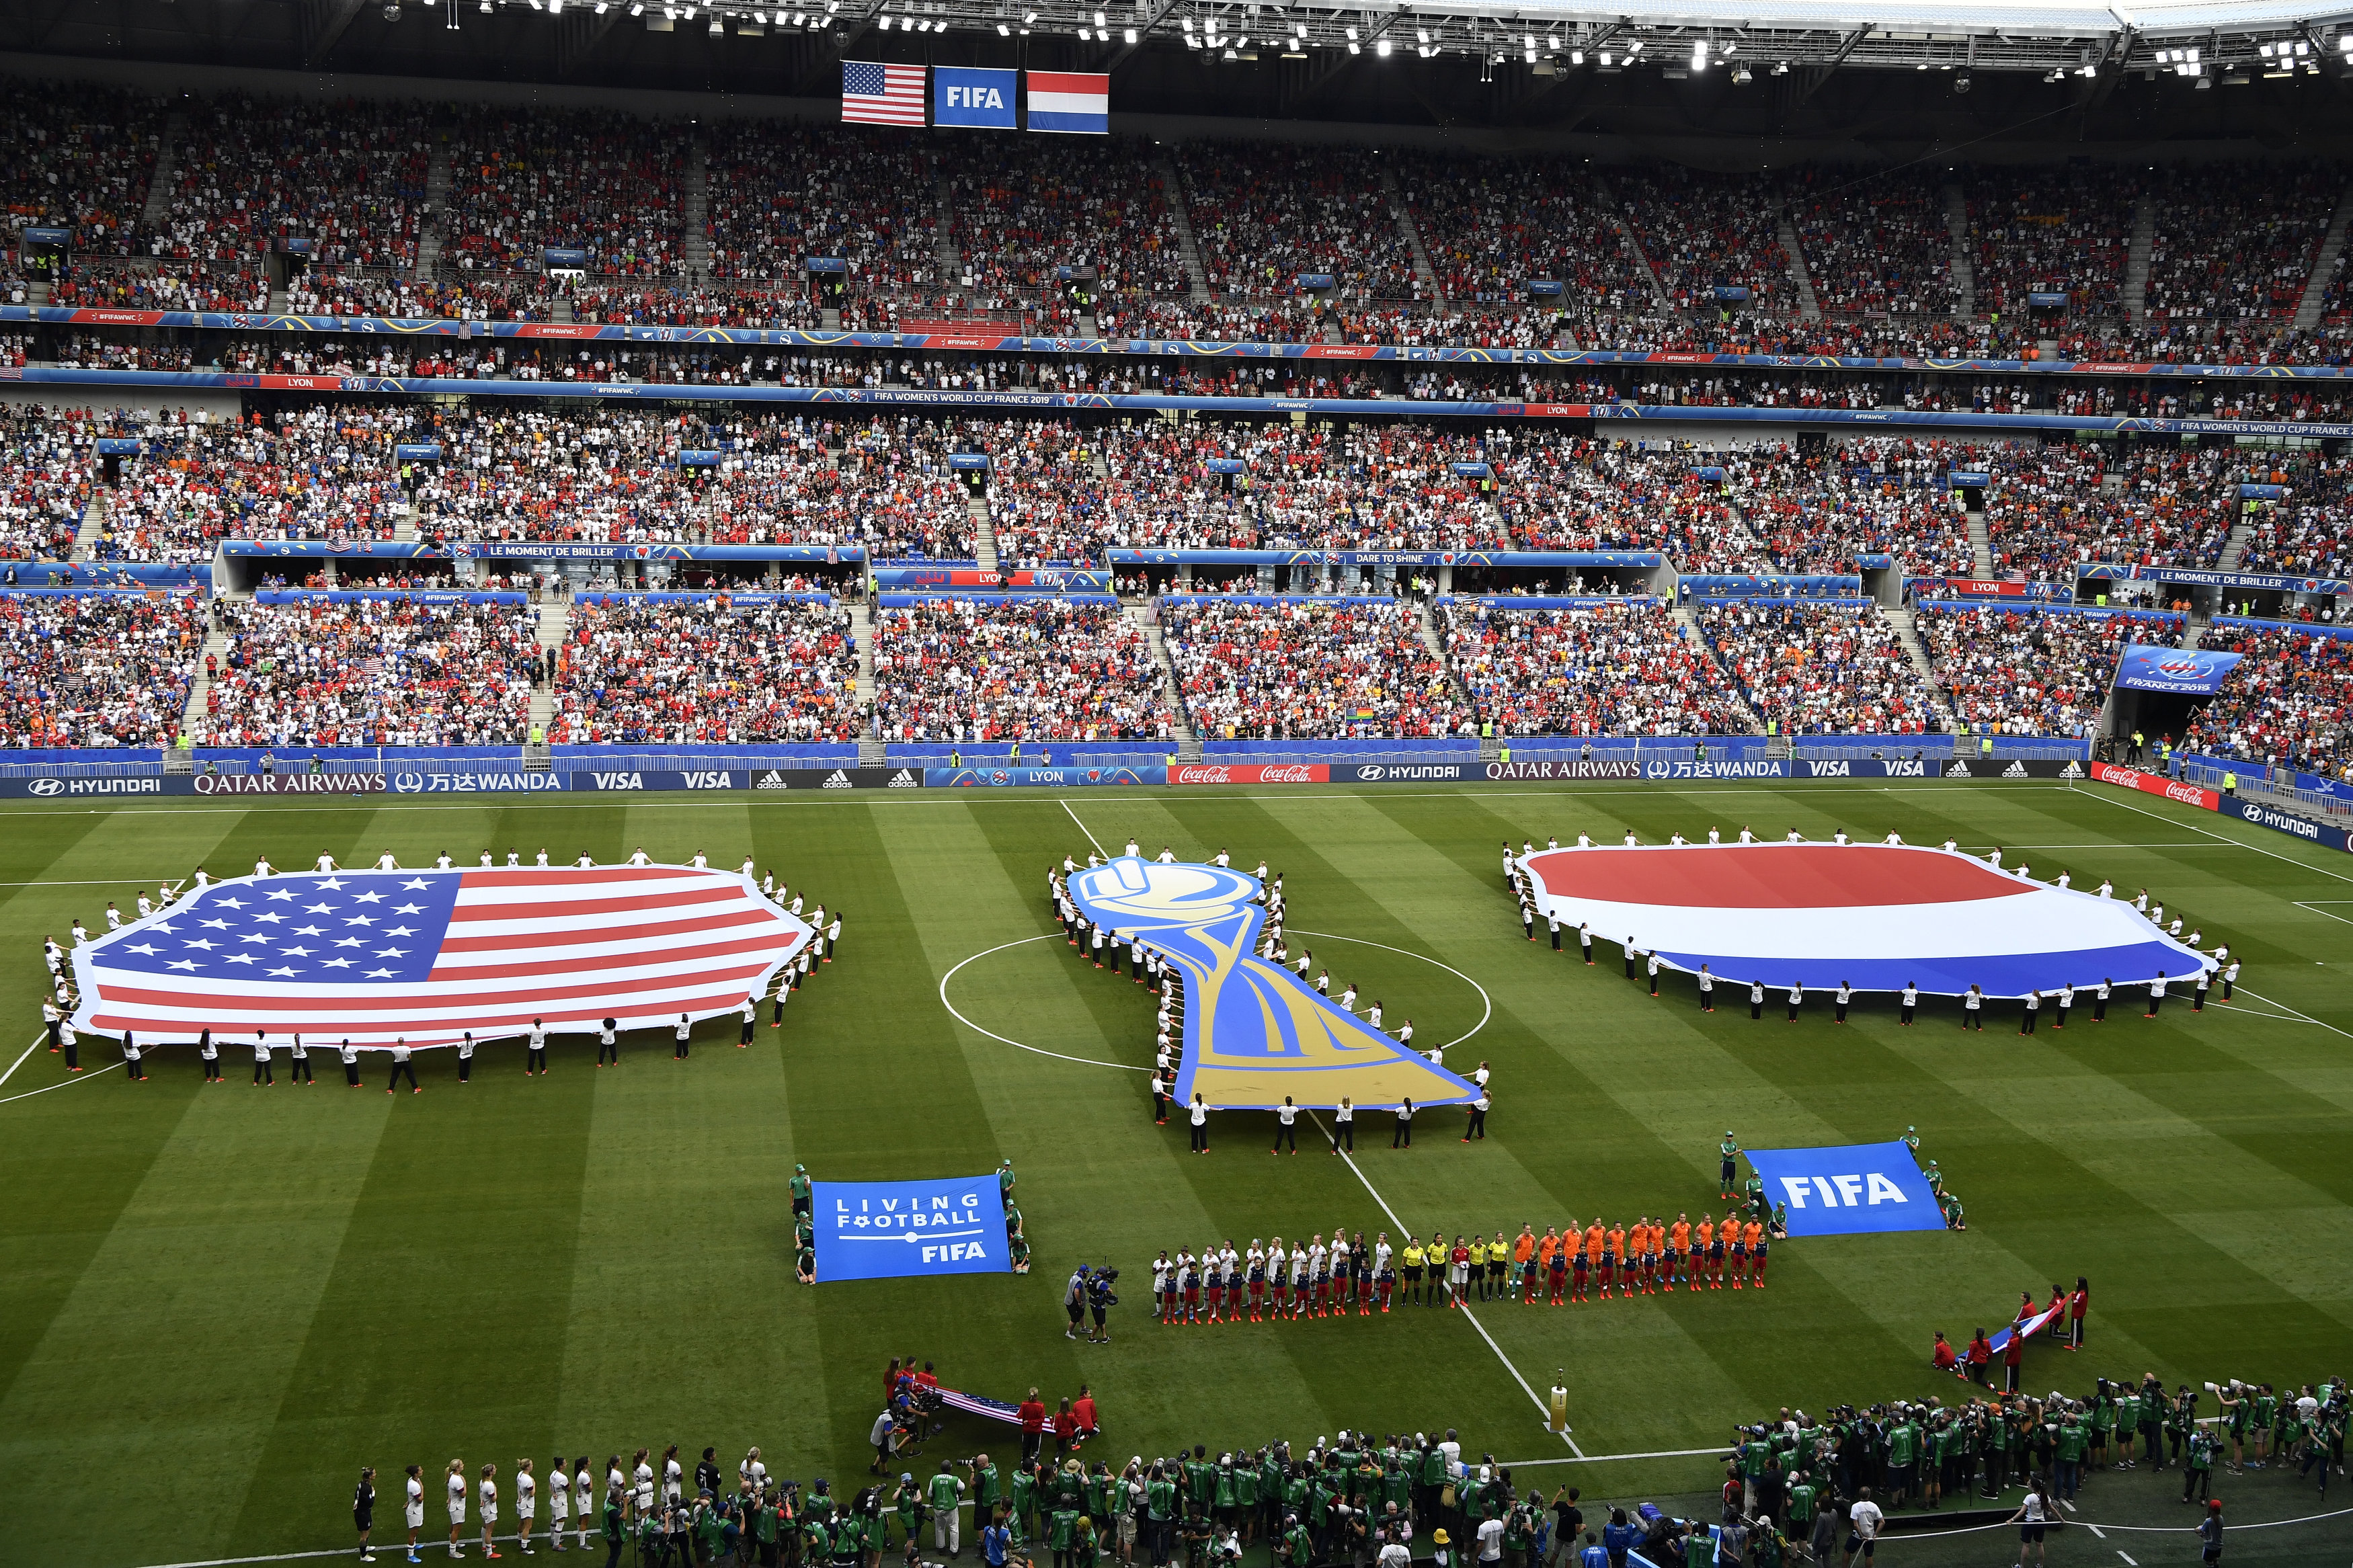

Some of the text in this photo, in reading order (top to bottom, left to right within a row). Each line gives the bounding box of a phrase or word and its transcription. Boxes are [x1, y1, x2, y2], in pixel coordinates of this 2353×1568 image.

[947, 86, 1004, 109] FIFA
[99, 313, 136, 321] #FIFAWWC
[288, 378, 314, 388] LYON
[598, 386, 634, 395] #FIFAWWC
[875, 392, 893, 401] FIFA
[895, 393, 938, 401] WOMEN'S
[940, 394, 972, 403] WORLD
[975, 394, 993, 403] CUP
[995, 395, 1029, 403] FRANCE
[1547, 407, 1568, 415] LYON
[2181, 422, 2348, 435] FIFA WOMEN'S WORLD CUP FRANCE
[491, 547, 504, 555] LE
[506, 547, 553, 556] MOMENT
[556, 547, 569, 556] DE
[1357, 554, 1379, 563] DARE
[1381, 554, 1394, 563] TO
[2161, 571, 2173, 579] LE
[2176, 572, 2221, 583] MOMENT
[2223, 575, 2239, 584] DE
[1972, 583, 1999, 592] LYON
[2126, 679, 2178, 690] FRANCE
[1389, 766, 1460, 778] HYUNDAI
[1486, 761, 1640, 780] QATAR AIRWAYS
[1673, 761, 1782, 778] 万达 WANDA
[1807, 761, 1850, 776] VISA
[1881, 761, 1924, 776] VISA
[2059, 770, 2085, 778] adidas
[428, 773, 561, 792] 万达 WANDA
[590, 773, 643, 789] VISA
[680, 772, 731, 788] VISA
[1030, 771, 1068, 782] LYON
[71, 779, 160, 793] HYUNDAI
[194, 773, 386, 794] QATAR AIRWAYS
[2265, 811, 2318, 839] HYUNDAI
[1780, 1173, 1909, 1208] FIFA
[837, 1194, 978, 1212] LIVING
[922, 1241, 986, 1264] FIFA
[1236, 1469, 1250, 1477] PHOTO
[700, 1475, 707, 1487] 21
[1013, 1475, 1026, 1484] PHOTO
[1315, 1485, 1327, 1497] PHOTO
[808, 1495, 822, 1503] PHOTO
